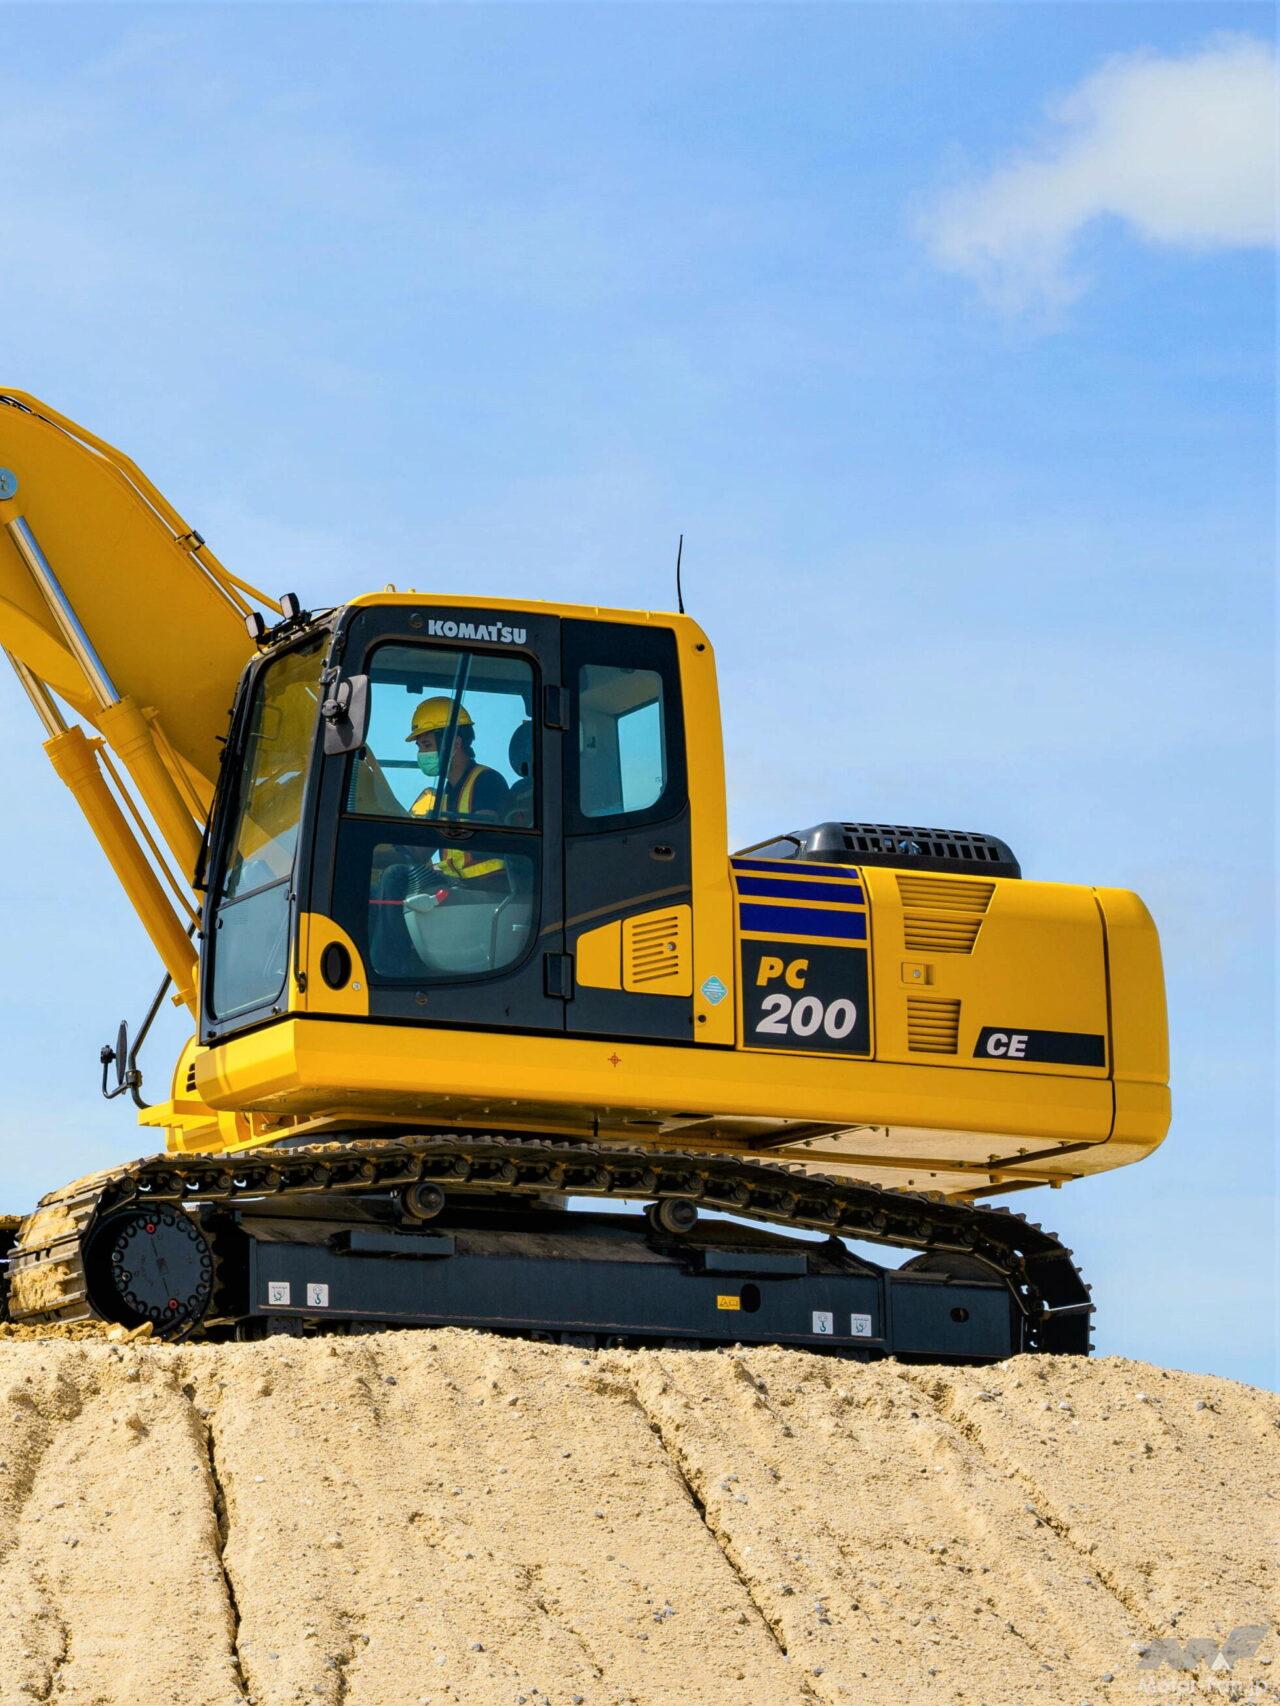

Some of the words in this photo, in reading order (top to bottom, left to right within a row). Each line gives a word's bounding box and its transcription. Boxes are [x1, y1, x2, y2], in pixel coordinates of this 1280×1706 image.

[428, 619, 527, 644] KOMATSU
[756, 956, 809, 989] PC
[755, 993, 857, 1039] 200
[986, 1033, 1029, 1058] CE
